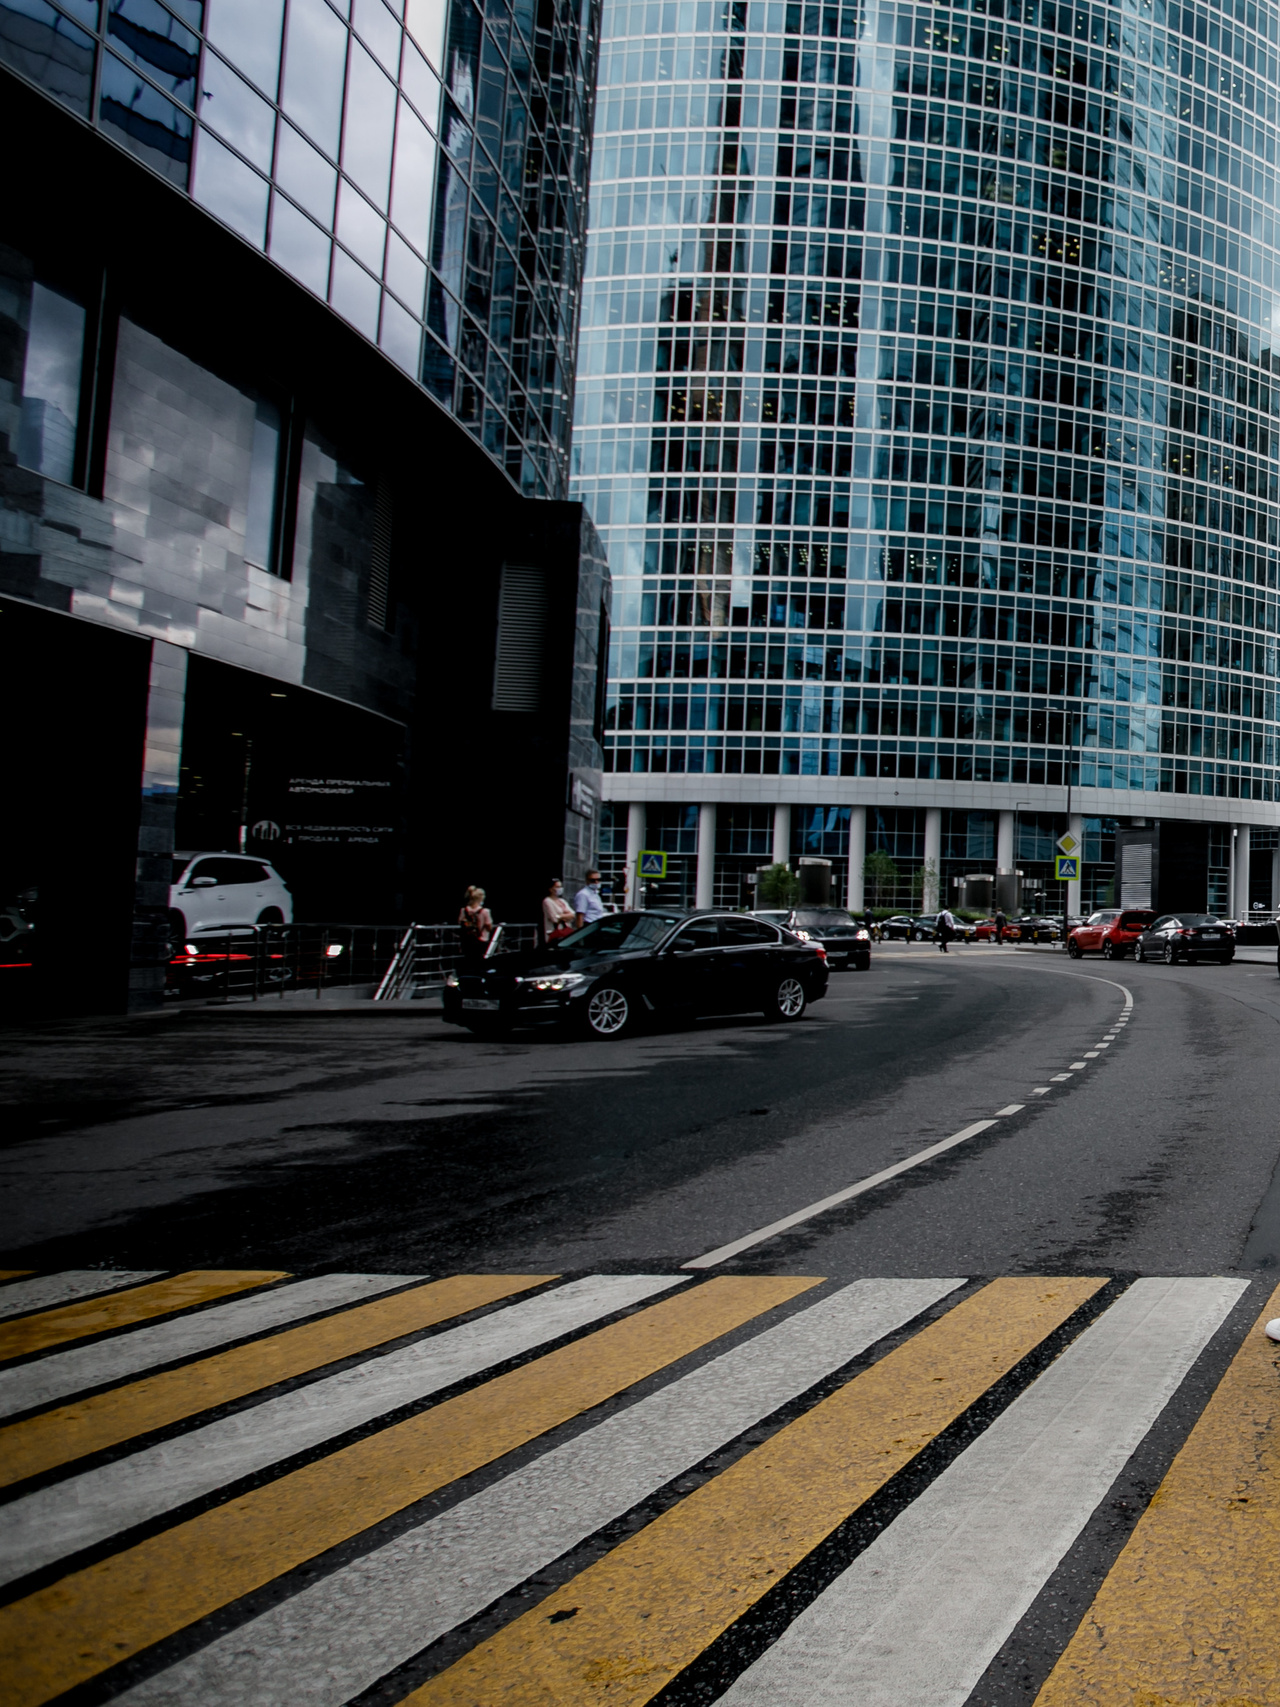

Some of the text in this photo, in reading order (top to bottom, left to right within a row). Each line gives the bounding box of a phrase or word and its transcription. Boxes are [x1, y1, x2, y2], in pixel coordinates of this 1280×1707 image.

[288, 778, 391, 787] АРЕНДА ПРЕМИАЛЬНЫХ
[288, 786, 354, 794] АВТОМОБИЛЕЙ
[303, 825, 371, 833] НЕДВИЖИМОСТЬ
[298, 835, 379, 844] ПРОДАЖА АРЕНДА
